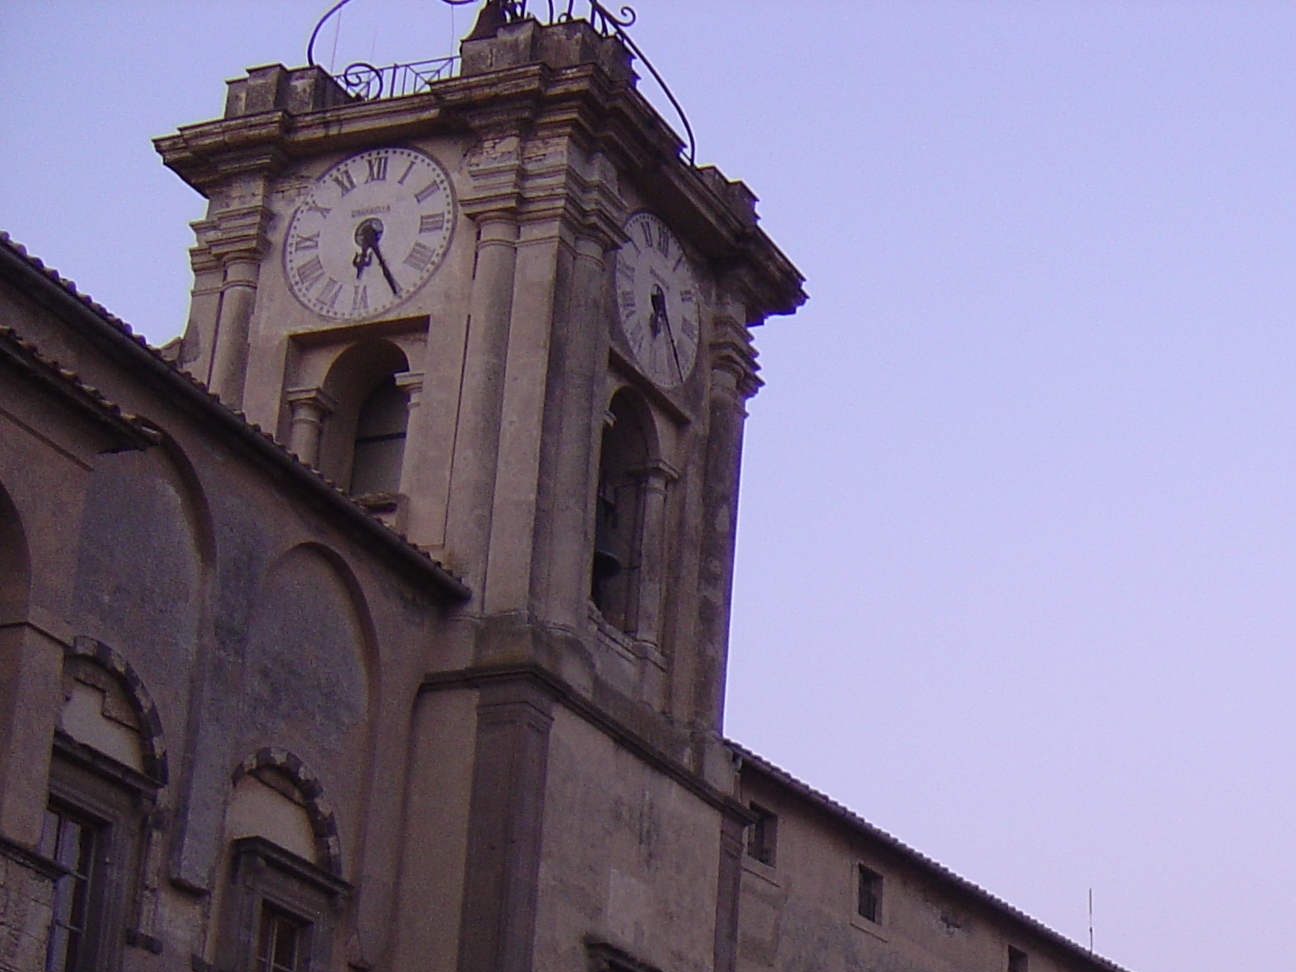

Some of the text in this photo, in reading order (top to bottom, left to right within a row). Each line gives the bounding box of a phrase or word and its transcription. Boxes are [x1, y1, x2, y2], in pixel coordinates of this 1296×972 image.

[364, 156, 389, 184] XII
[397, 161, 416, 185] I
[333, 170, 357, 197] XI
[415, 180, 440, 204] II
[307, 199, 332, 219] X
[419, 212, 445, 234] III
[295, 231, 320, 253] IX
[352, 285, 369, 311] VI
